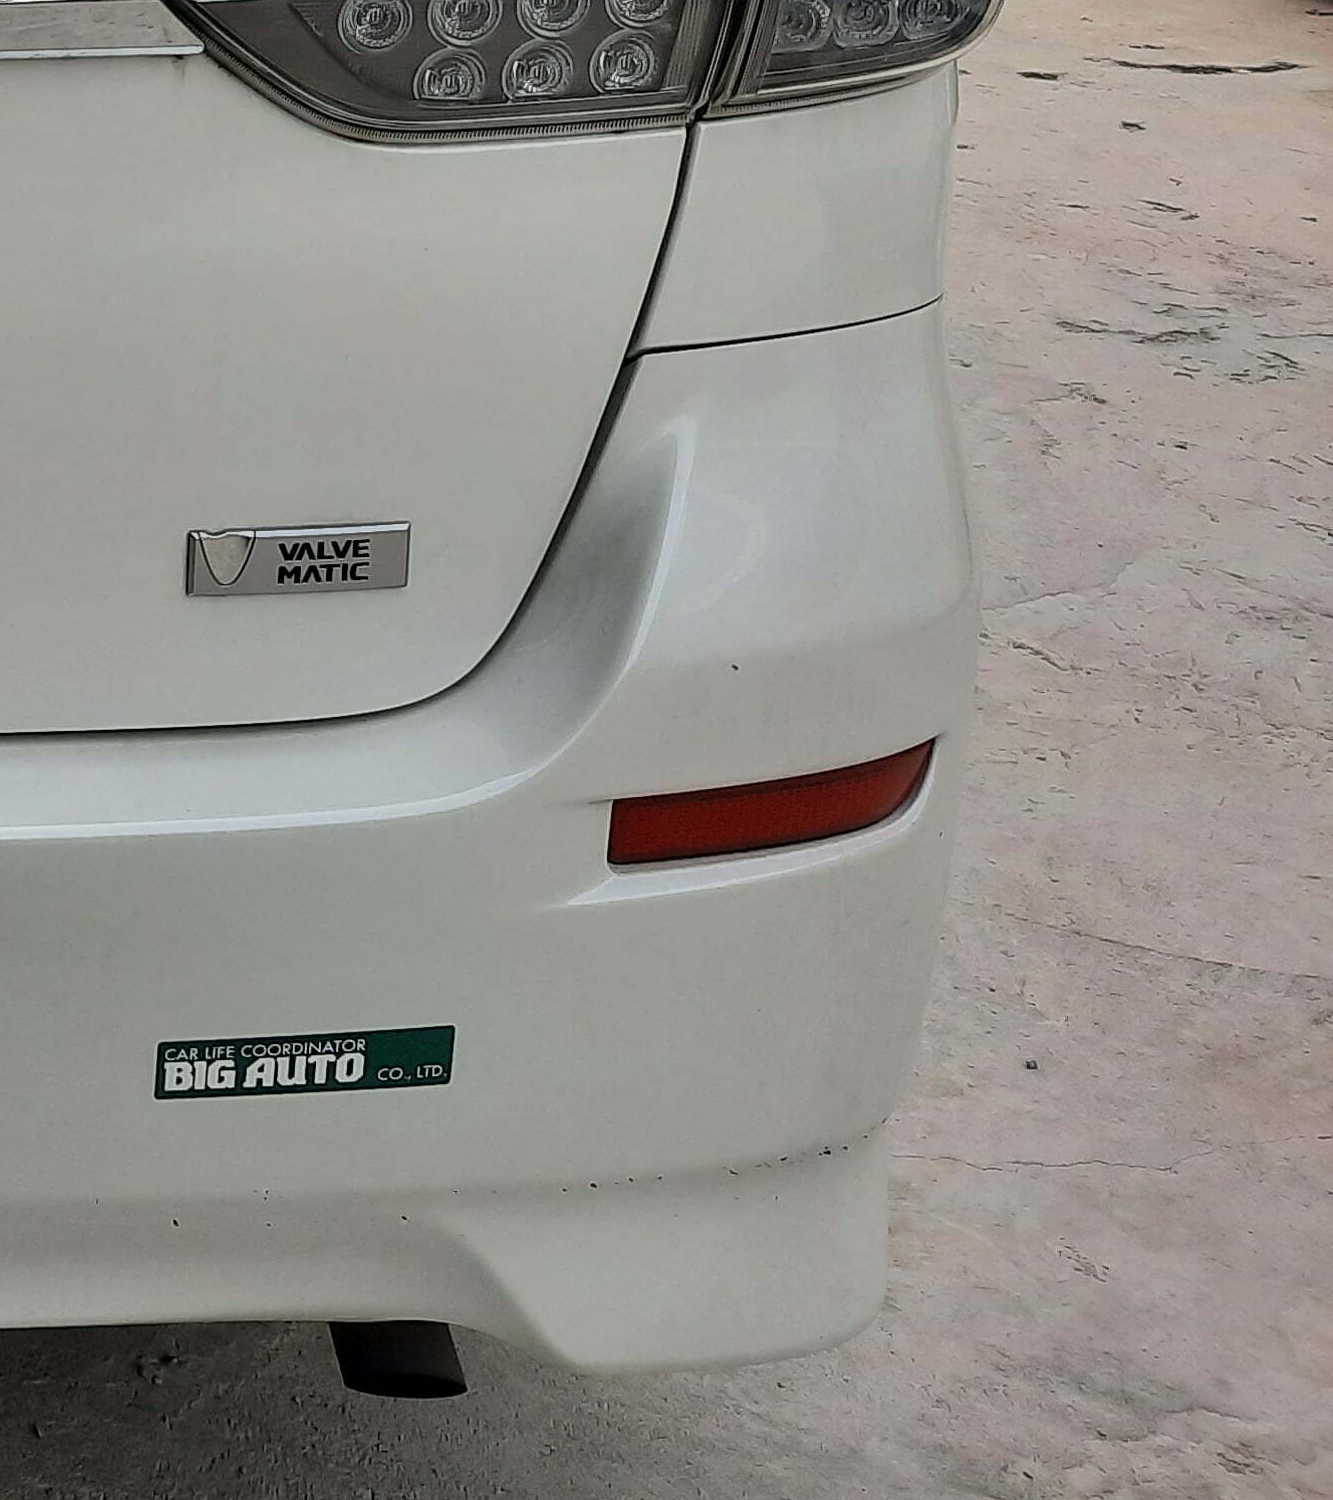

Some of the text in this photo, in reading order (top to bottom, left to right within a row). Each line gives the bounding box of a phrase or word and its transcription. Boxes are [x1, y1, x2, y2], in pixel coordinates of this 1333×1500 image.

[278, 539, 370, 561] VALVE
[277, 562, 370, 584] MATIC
[164, 1039, 366, 1062] CAR LIFE COORDINATOR
[163, 1059, 237, 1093] BIG
[243, 1052, 366, 1088] AUTO
